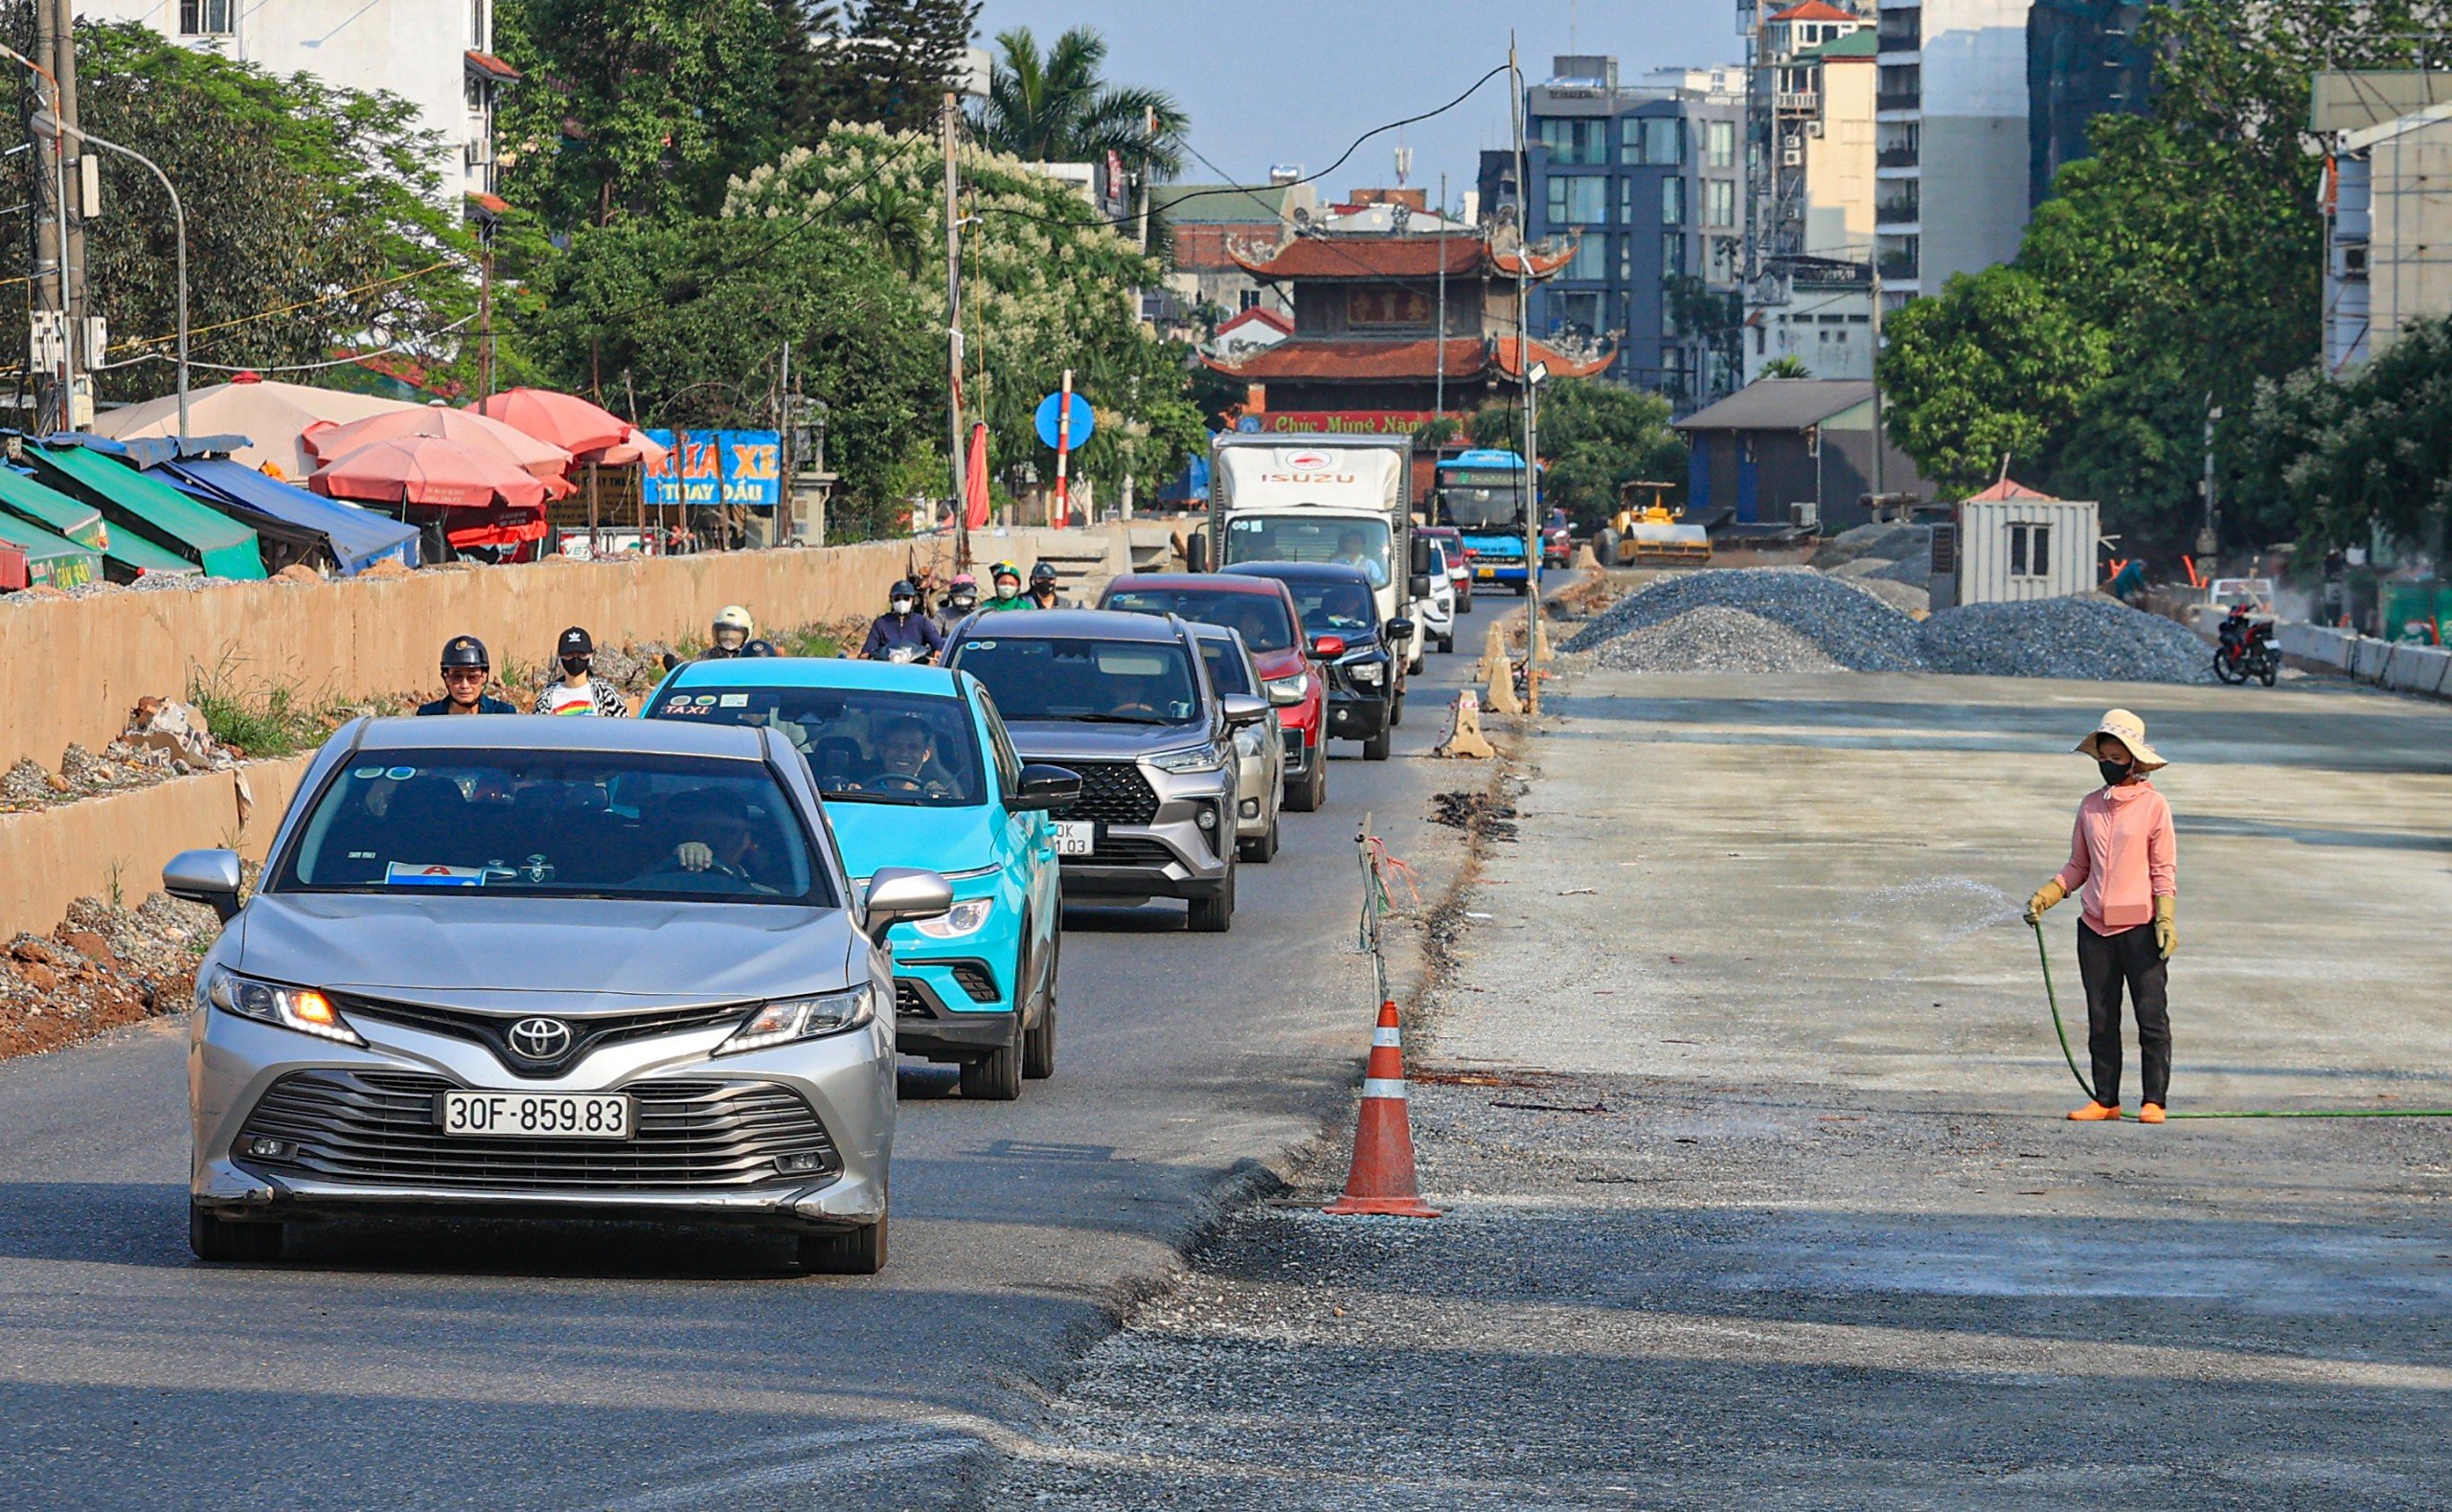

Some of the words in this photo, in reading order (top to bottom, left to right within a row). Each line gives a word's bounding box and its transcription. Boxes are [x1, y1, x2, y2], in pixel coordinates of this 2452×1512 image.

[732, 444, 780, 479] XE
[1261, 474, 1354, 483] ISUZU
[662, 484, 715, 500] THAY
[666, 705, 709, 714] TAXI
[450, 1097, 623, 1133] 30F-859.83
